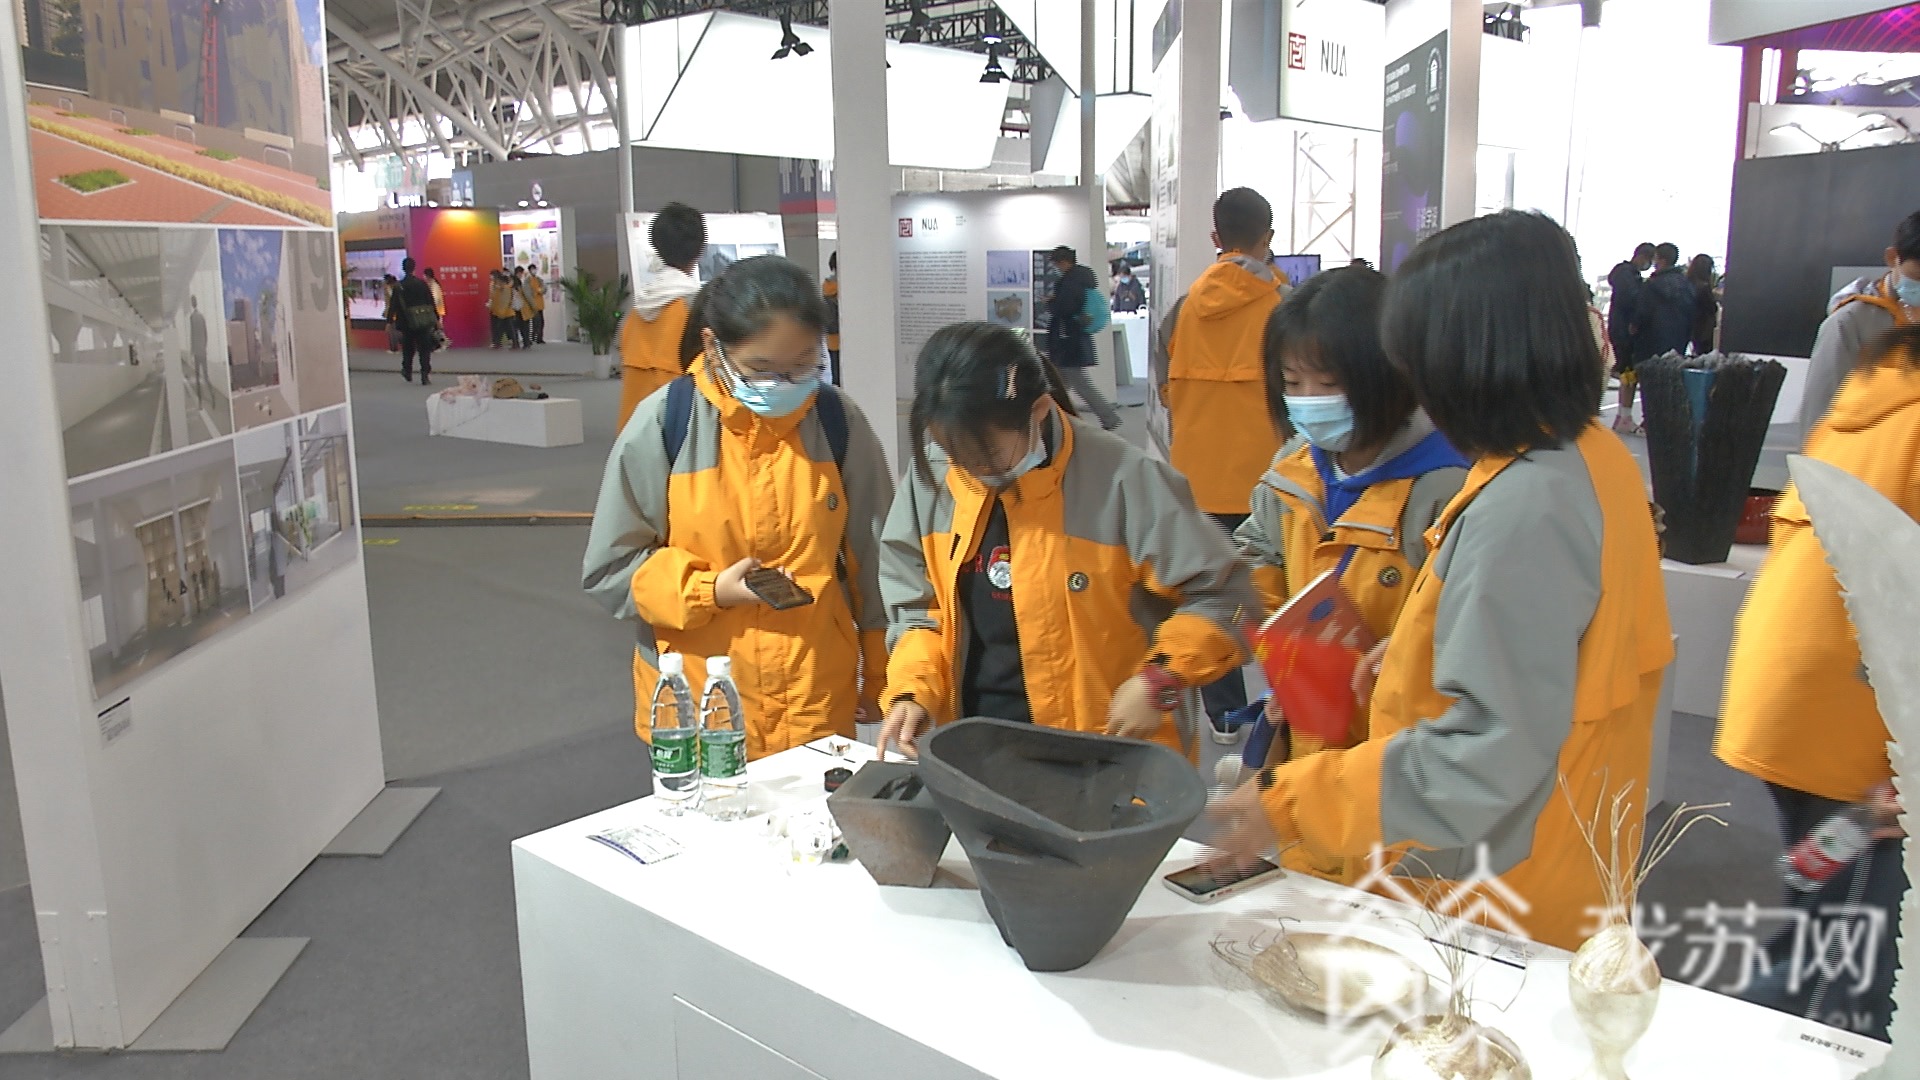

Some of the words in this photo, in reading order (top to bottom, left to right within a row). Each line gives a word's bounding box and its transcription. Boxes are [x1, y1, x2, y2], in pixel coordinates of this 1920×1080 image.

[1320, 39, 1347, 77] NUA
[921, 217, 938, 231] NUA
[286, 231, 337, 313] 19
